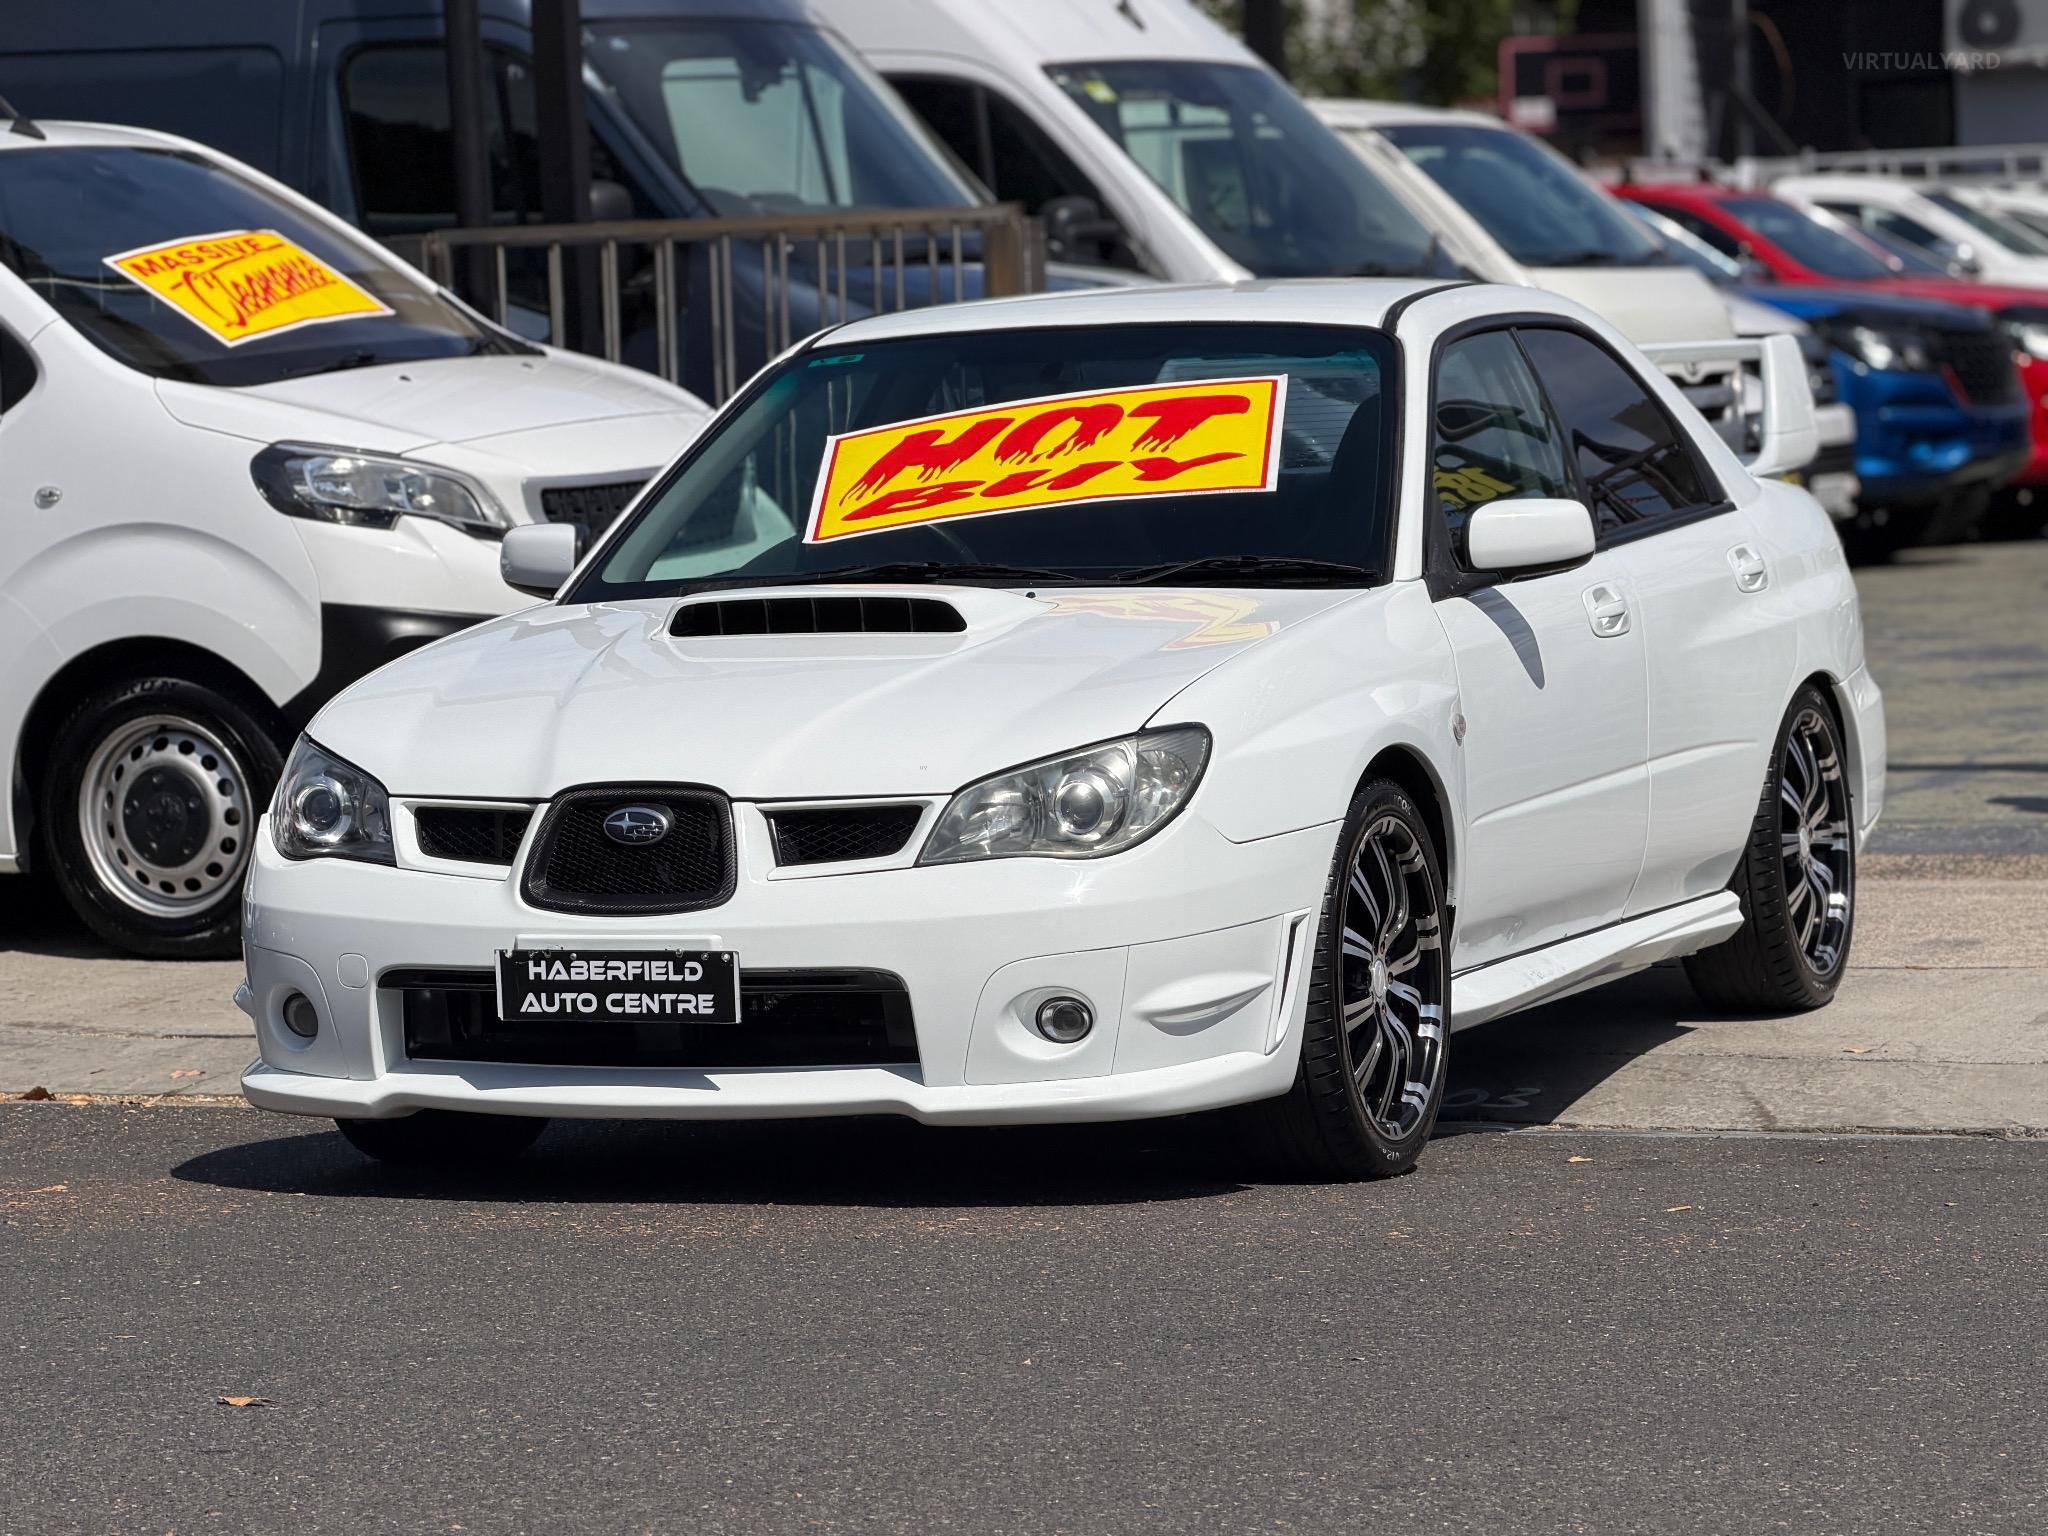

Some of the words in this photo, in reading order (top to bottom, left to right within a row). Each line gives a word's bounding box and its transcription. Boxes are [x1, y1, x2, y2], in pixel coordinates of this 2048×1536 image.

[130, 238, 262, 276] MASSIVE
[839, 395, 1251, 507] HOT
[841, 452, 1248, 522] BUY
[528, 960, 703, 982] HABERFIELD
[520, 992, 598, 1013] AUTO
[605, 993, 715, 1015] CENTRE
